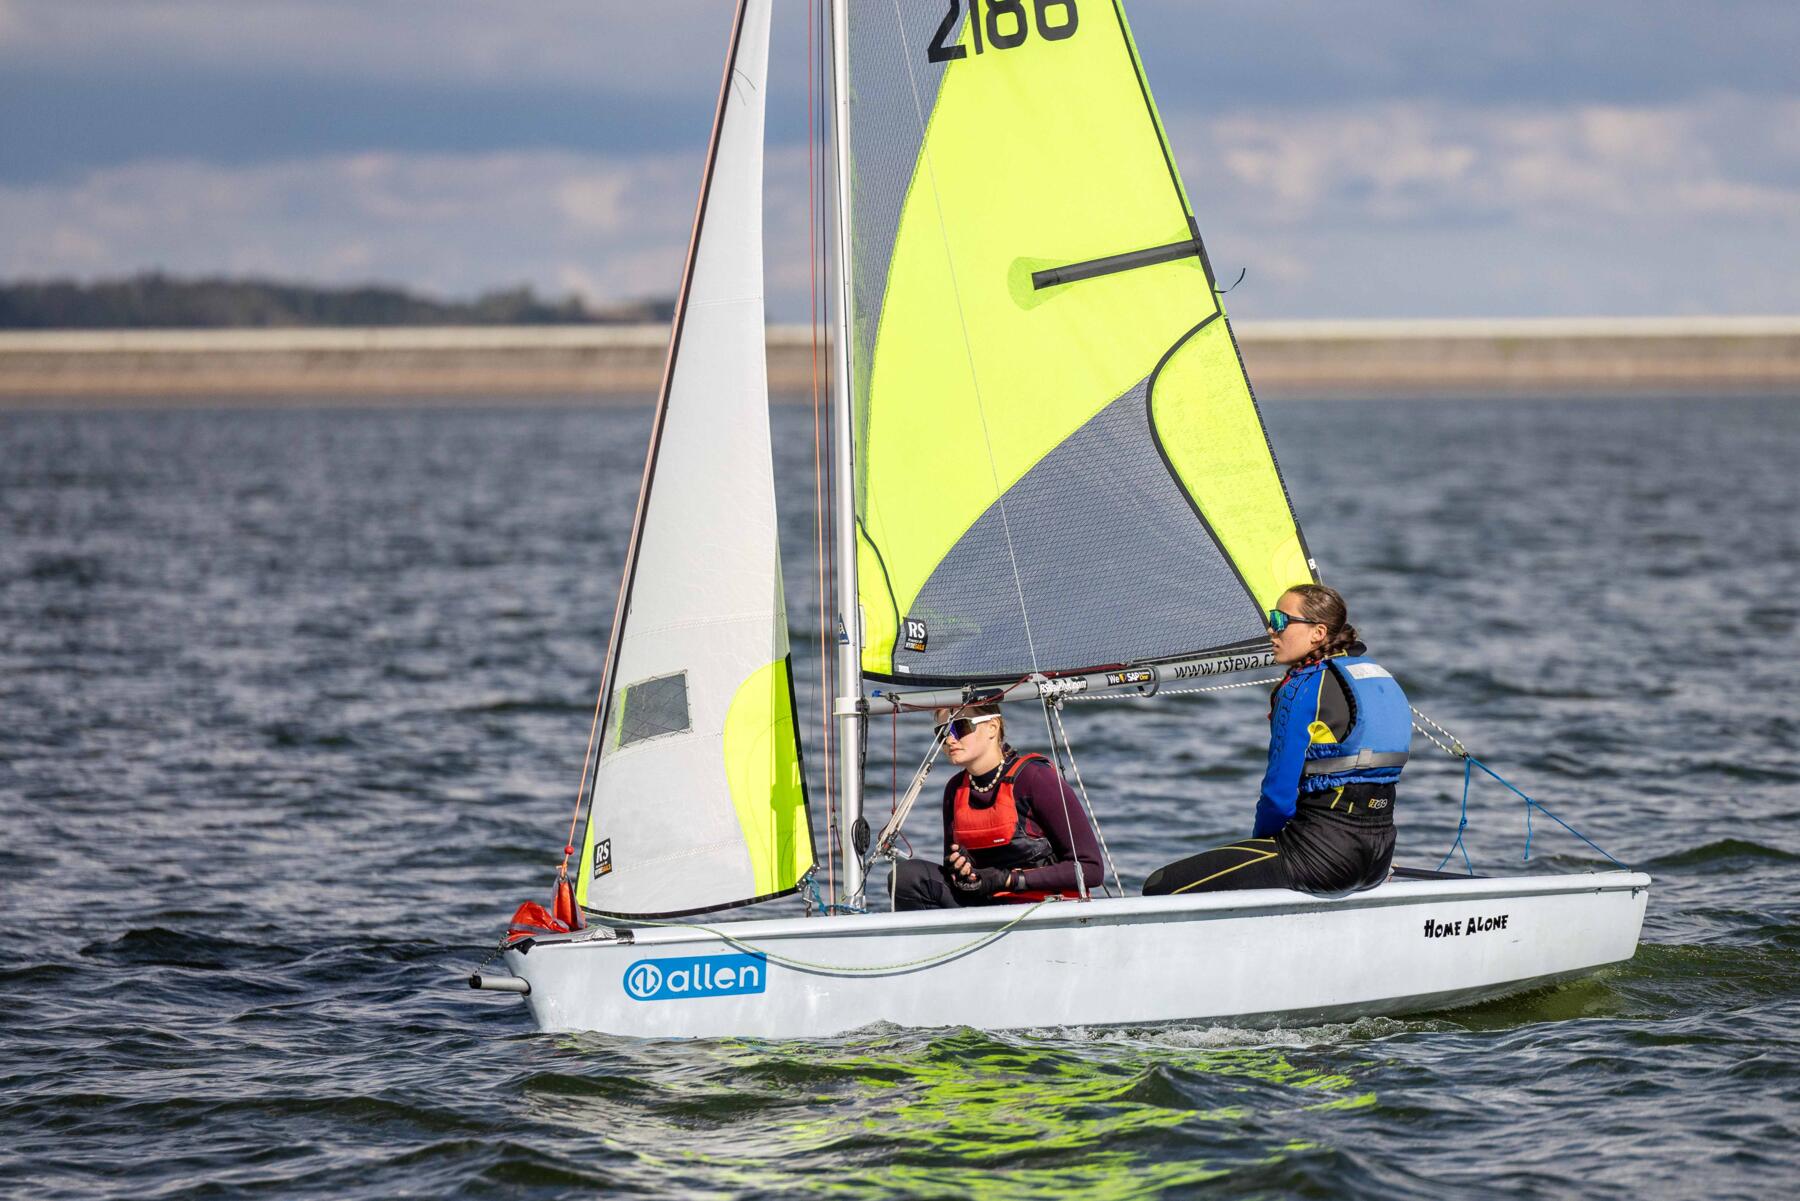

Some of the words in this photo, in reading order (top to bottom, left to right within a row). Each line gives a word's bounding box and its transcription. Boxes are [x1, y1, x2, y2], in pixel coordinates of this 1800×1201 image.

[908, 621, 925, 639] RS
[1108, 674, 1120, 685] We
[1126, 671, 1140, 682] SAP
[596, 841, 610, 864] RS
[666, 963, 759, 993] allen
